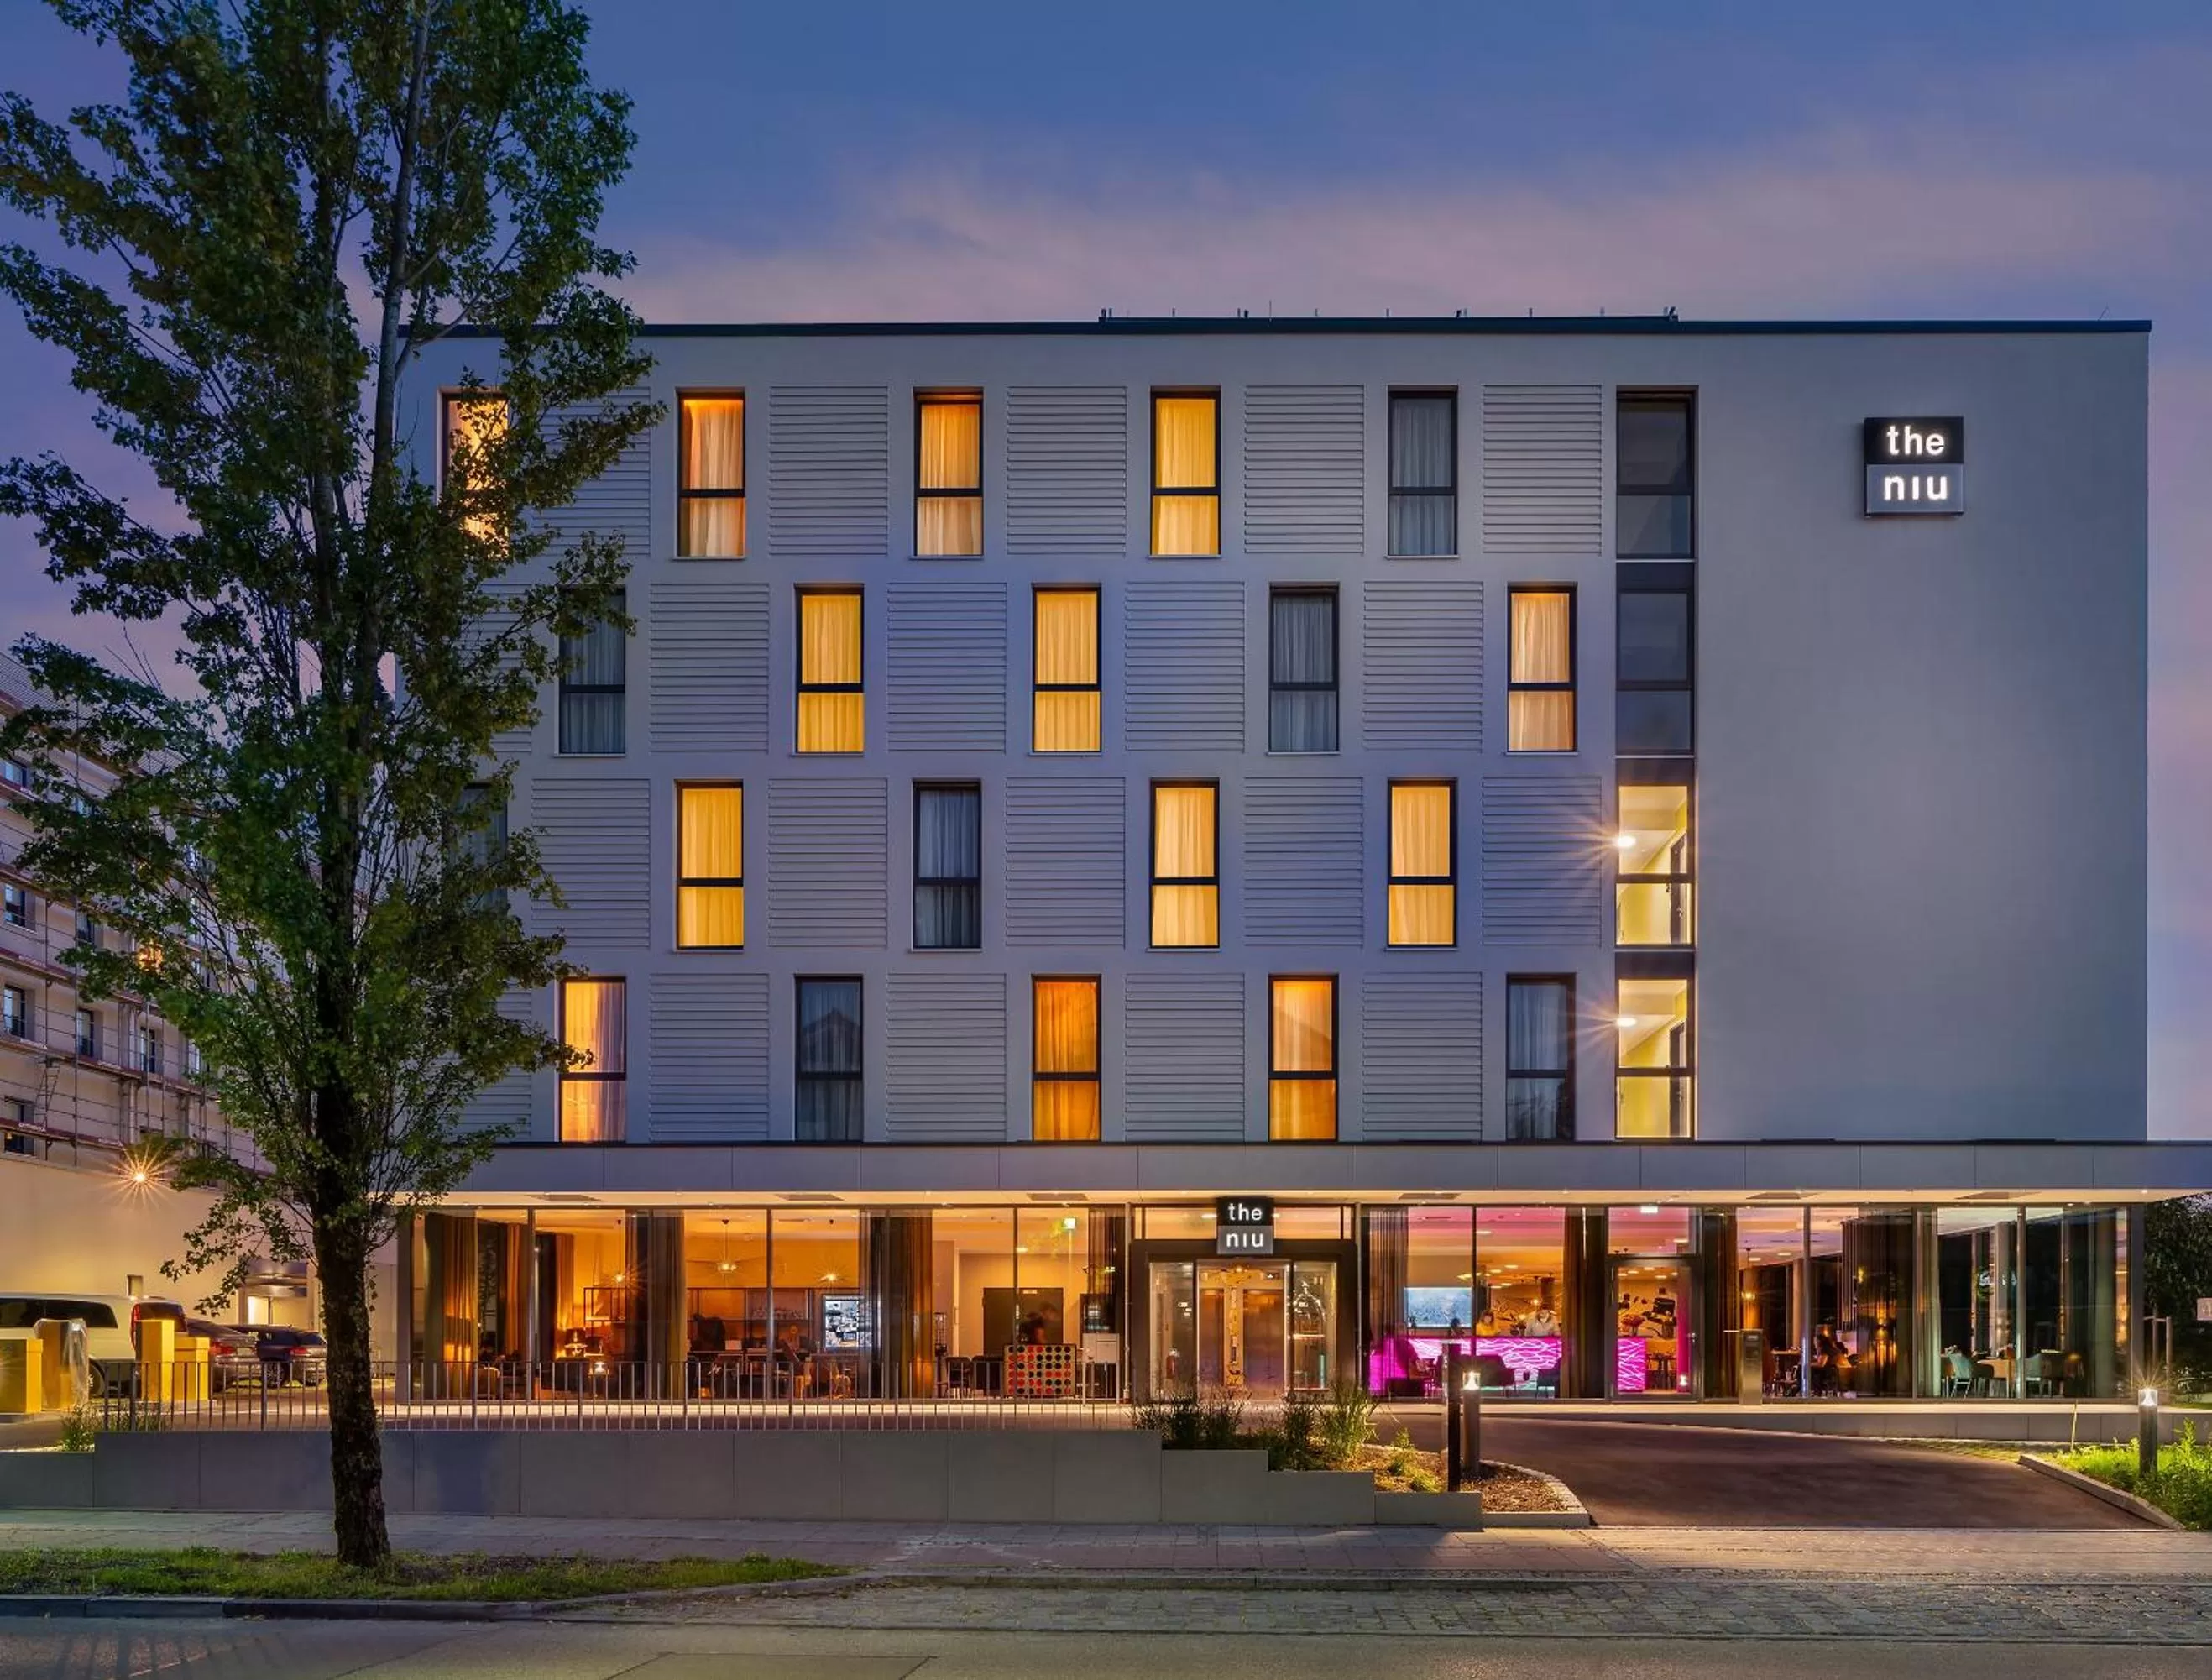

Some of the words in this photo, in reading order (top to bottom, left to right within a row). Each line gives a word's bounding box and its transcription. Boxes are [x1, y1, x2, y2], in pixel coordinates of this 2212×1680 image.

[1886, 425, 1945, 455] the
[1884, 475, 1948, 501] niu
[1228, 1202, 1263, 1221] the
[1226, 1233, 1263, 1248] niu
